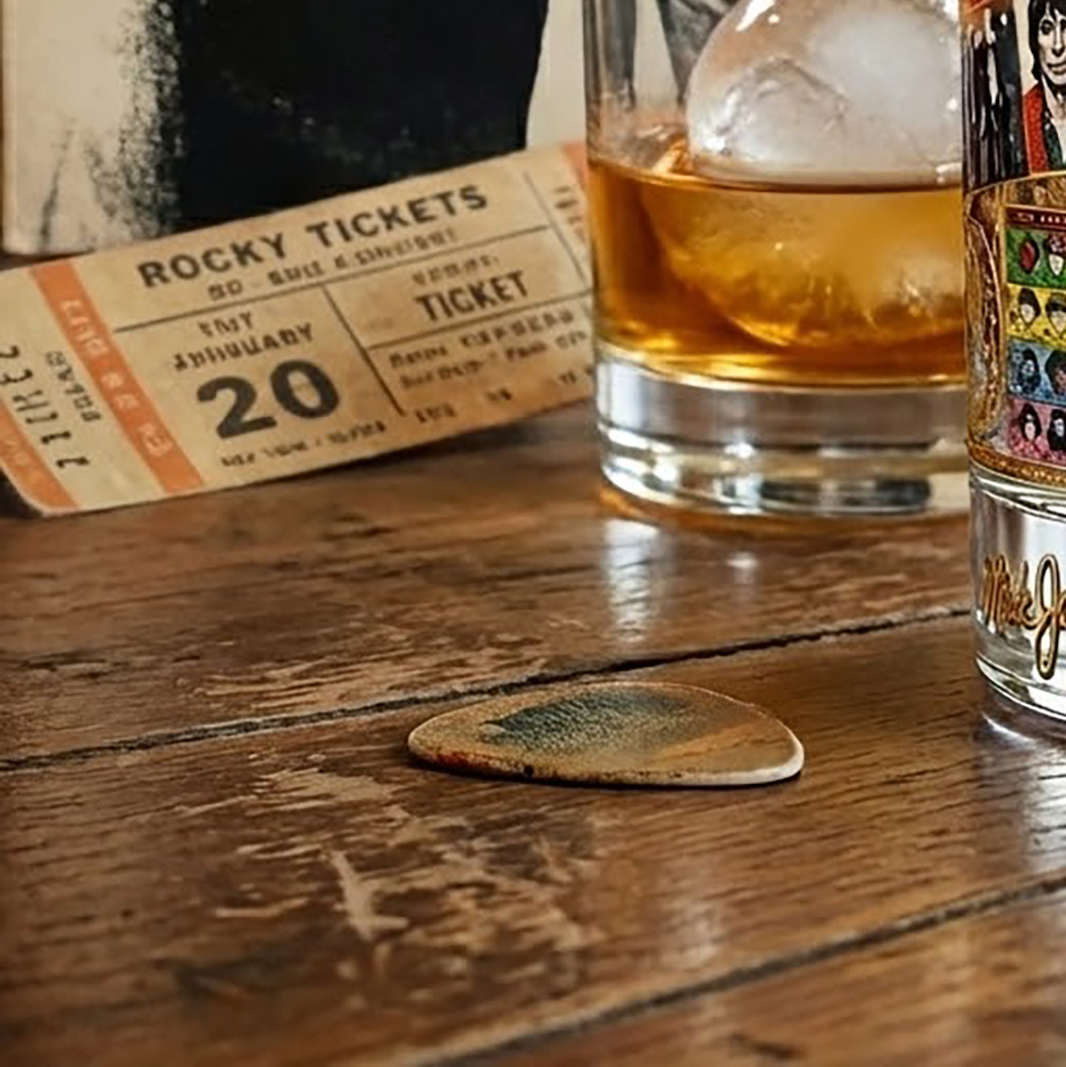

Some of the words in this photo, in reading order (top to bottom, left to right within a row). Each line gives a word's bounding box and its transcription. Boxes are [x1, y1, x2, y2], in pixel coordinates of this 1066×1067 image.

[138, 232, 286, 288] ROCKY
[305, 184, 488, 249] TICKETS
[196, 359, 340, 439] 20
